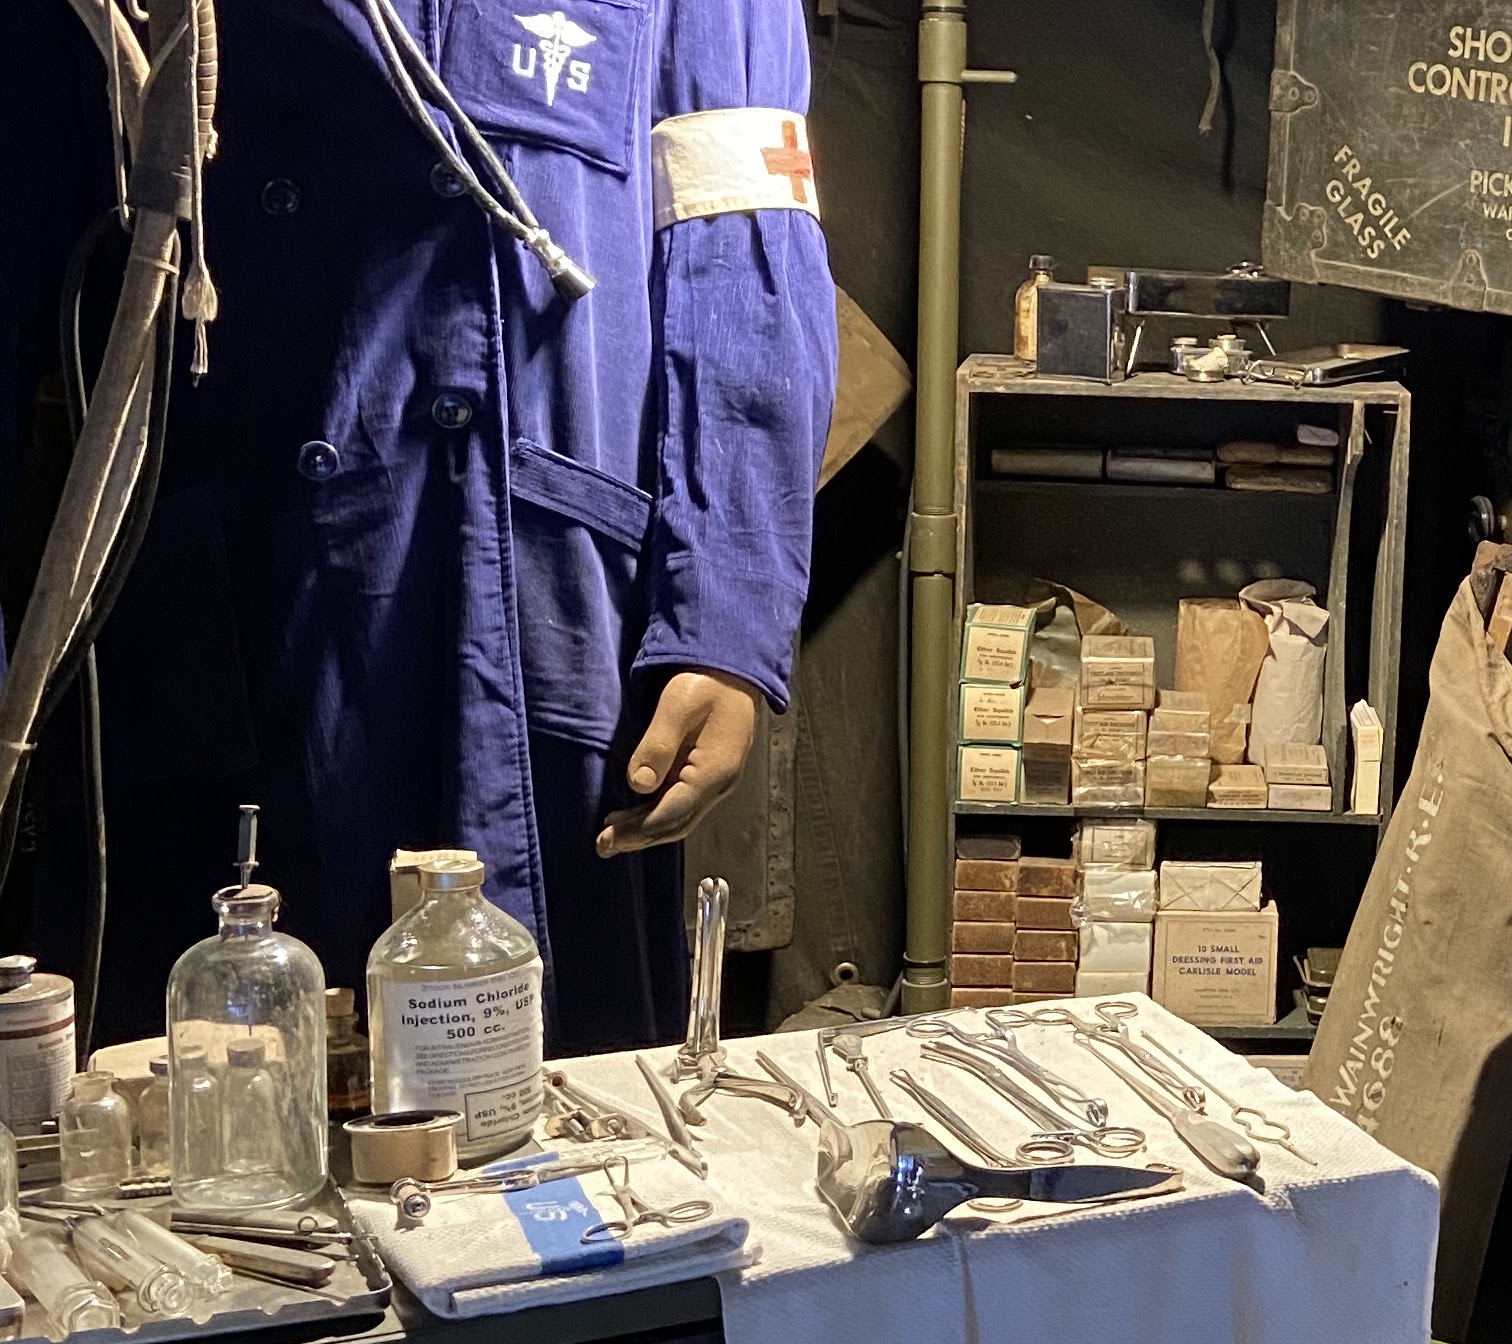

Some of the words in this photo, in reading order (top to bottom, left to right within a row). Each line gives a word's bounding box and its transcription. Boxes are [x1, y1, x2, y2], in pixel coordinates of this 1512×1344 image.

[1334, 144, 1411, 251] FRAGILE
[1326, 179, 1385, 259] GLASS
[1198, 945, 1207, 953] 10
[1210, 945, 1240, 953] SMALL
[1172, 956, 1217, 964] DRESSING
[1248, 957, 1263, 965] AID
[1178, 967, 1221, 975] CARLISLE
[1225, 967, 1256, 976] MODEL
[408, 998, 467, 1009] Sodium
[475, 982, 530, 1004] Chloride
[401, 1013, 475, 1027] Injection,
[515, 993, 534, 1010] USP
[447, 1027, 475, 1040] 500
[484, 1024, 506, 1034] cc.
